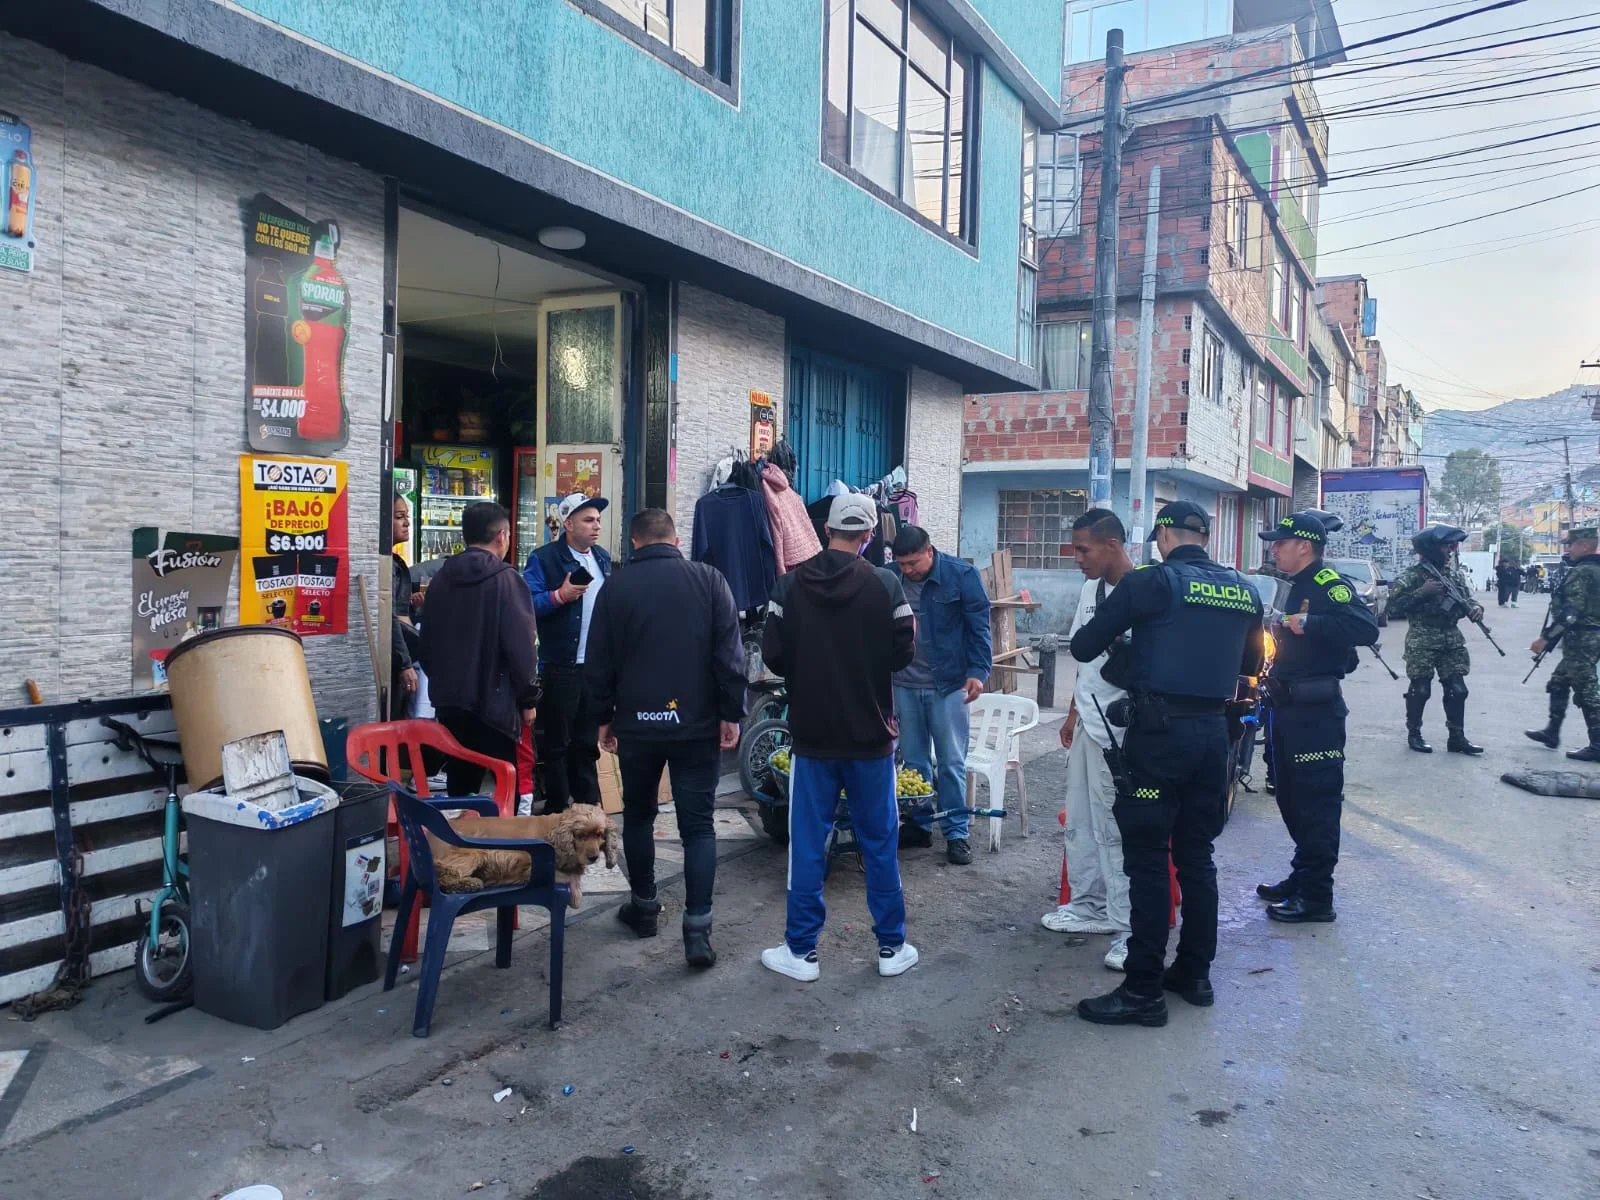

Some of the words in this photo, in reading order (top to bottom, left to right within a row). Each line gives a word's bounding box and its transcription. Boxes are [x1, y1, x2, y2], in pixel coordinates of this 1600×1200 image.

[255, 233, 270, 246] CON
[270, 236, 284, 249] LOS
[284, 240, 298, 254] 500
[256, 221, 269, 234] NO
[270, 225, 279, 237] TE
[280, 228, 311, 246] QUEDES
[266, 495, 324, 520] ¡BAJÓ
[270, 520, 284, 529] DE
[285, 520, 324, 529] PRECIO!
[147, 548, 221, 577] Fusión
[137, 590, 158, 617] El
[262, 589, 294, 599] SELECTO
[1190, 581, 1253, 604] POLICÍA
[149, 606, 187, 633] mesa
